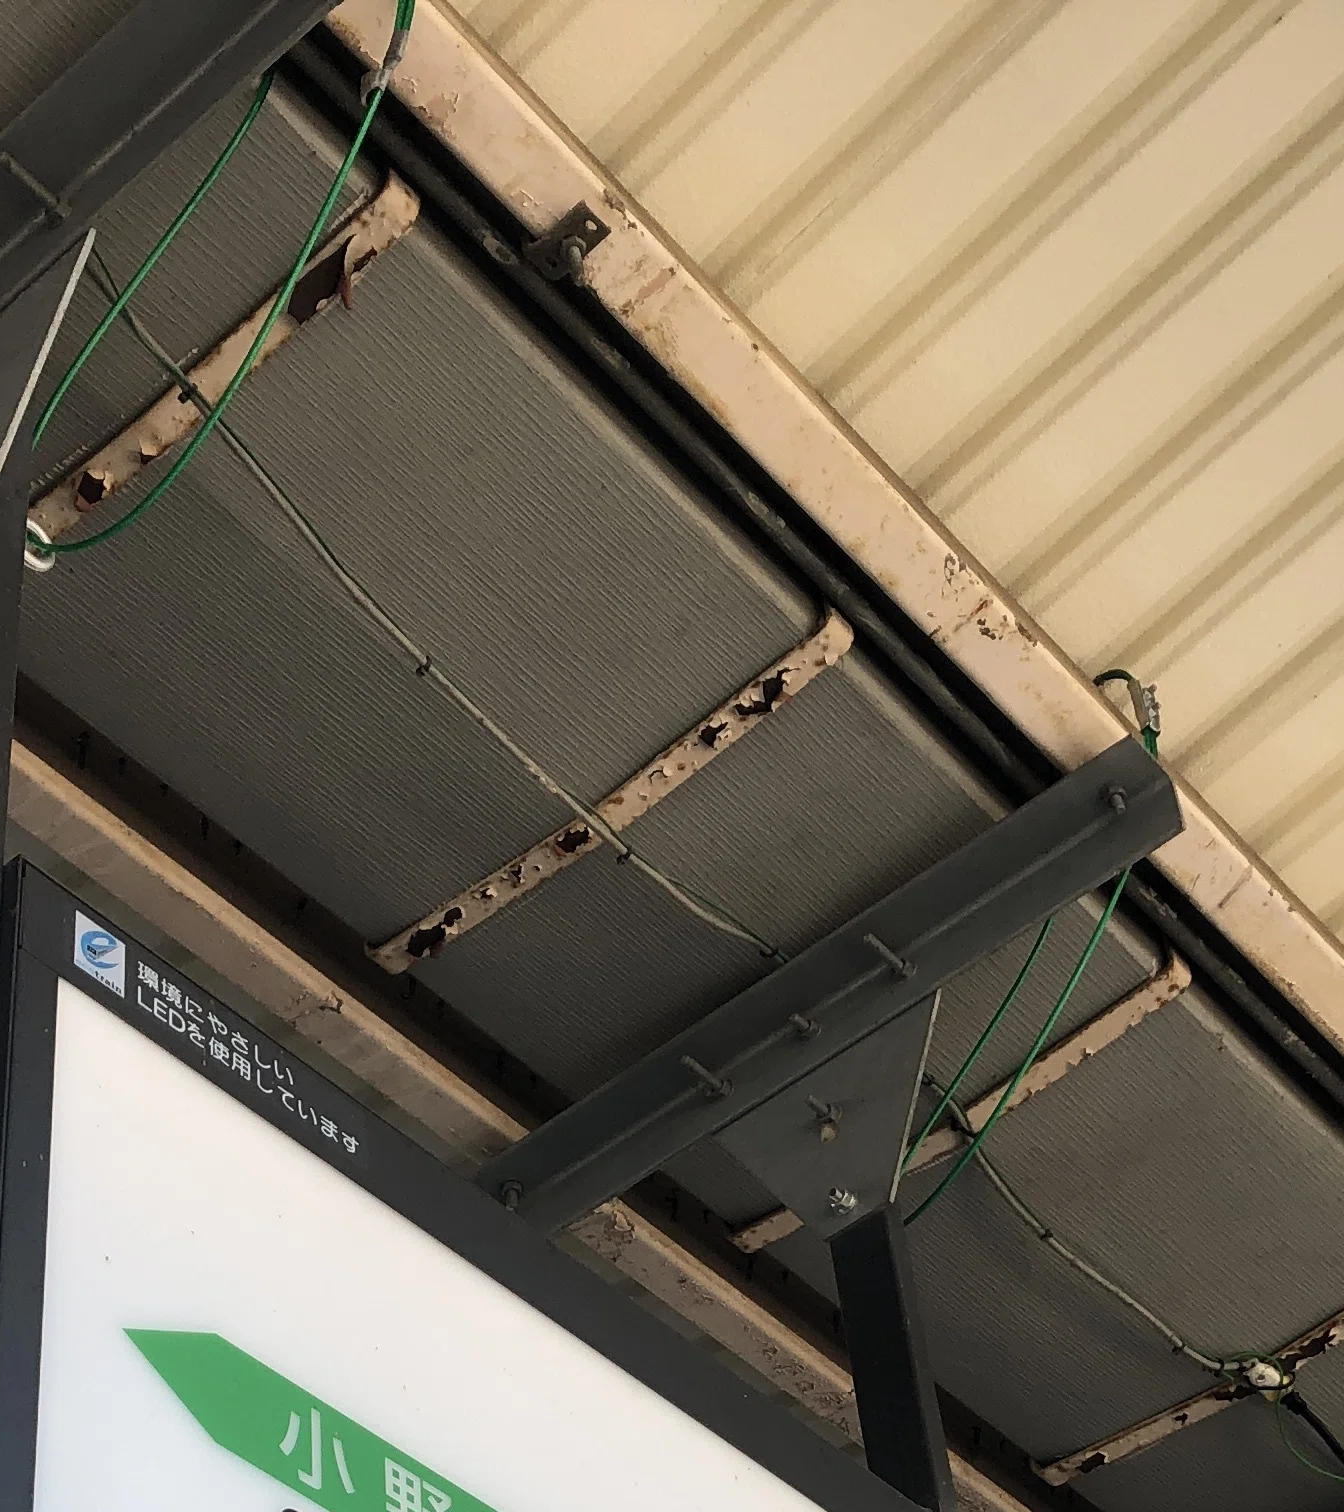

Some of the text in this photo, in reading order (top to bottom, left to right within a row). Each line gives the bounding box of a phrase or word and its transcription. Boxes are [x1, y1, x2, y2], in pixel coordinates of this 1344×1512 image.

[137, 960, 294, 1085] 環境にやさしい
[137, 986, 359, 1153] LEDを使用しています
